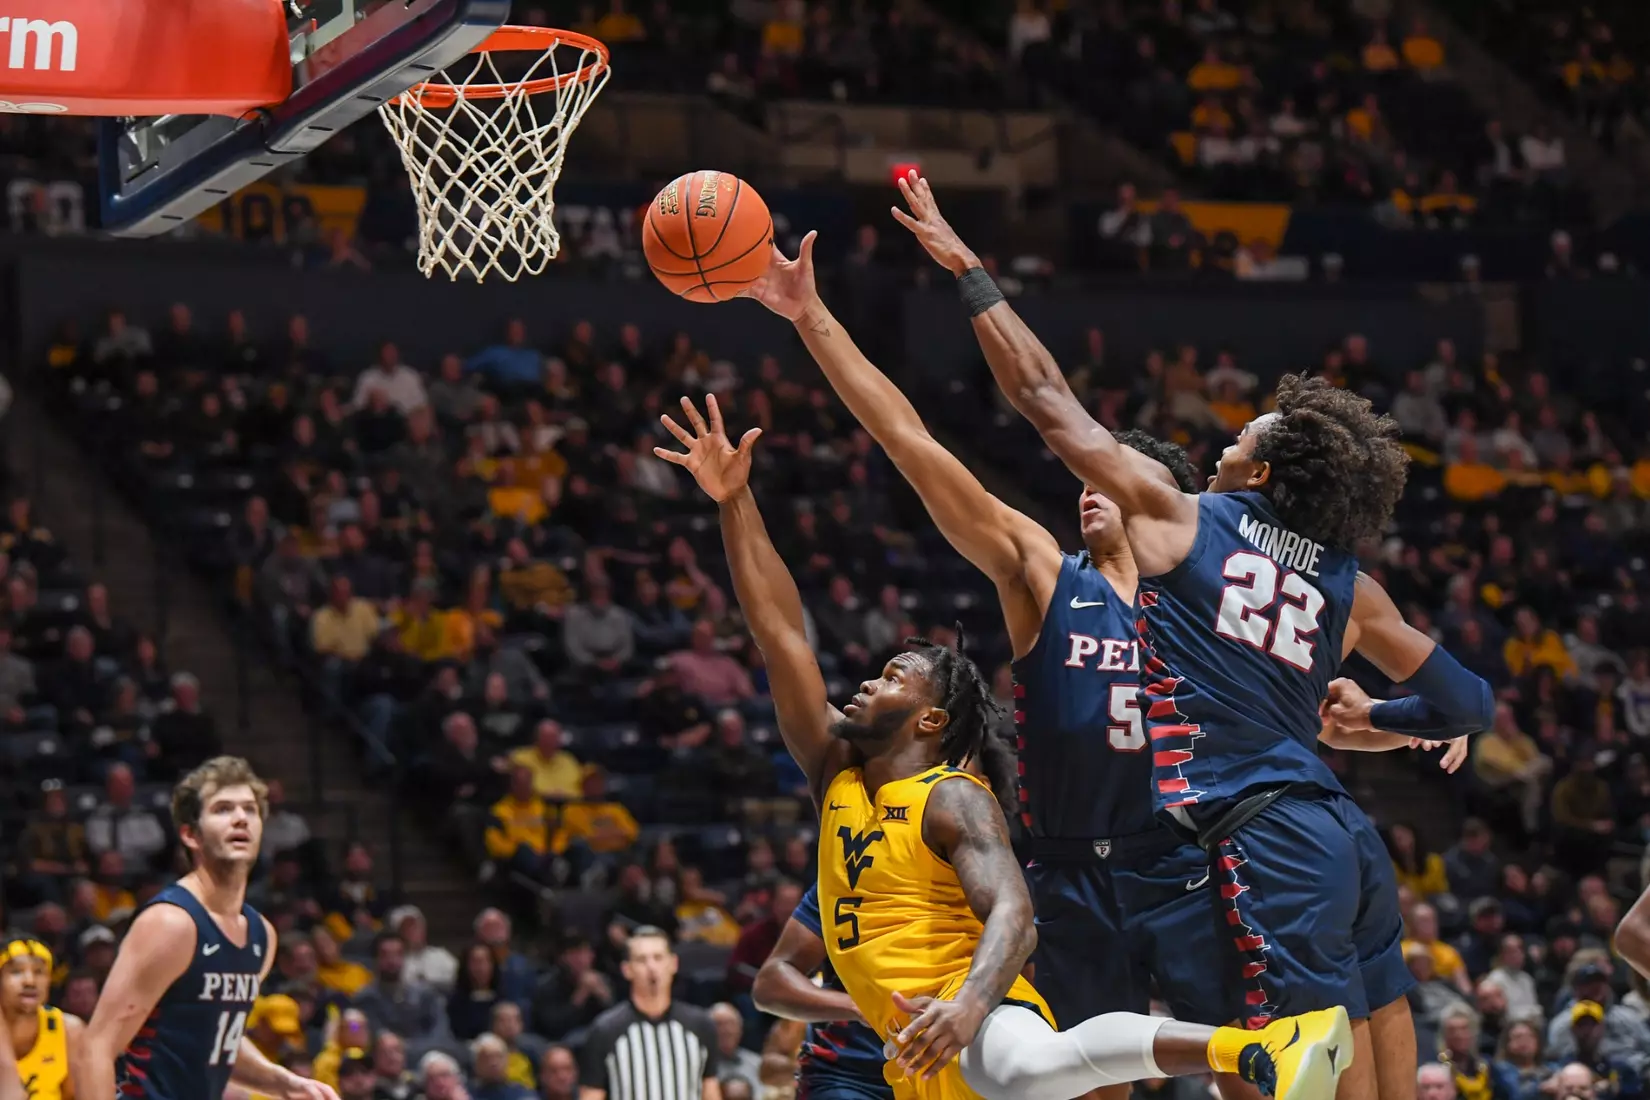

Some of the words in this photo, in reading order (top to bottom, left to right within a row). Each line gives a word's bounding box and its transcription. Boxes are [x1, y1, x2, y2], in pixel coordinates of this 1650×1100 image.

[1238, 513, 1325, 578] MONROE
[1214, 549, 1326, 673] 22
[1106, 683, 1148, 752] 5
[834, 897, 864, 950] 5
[208, 1010, 247, 1065] 14
